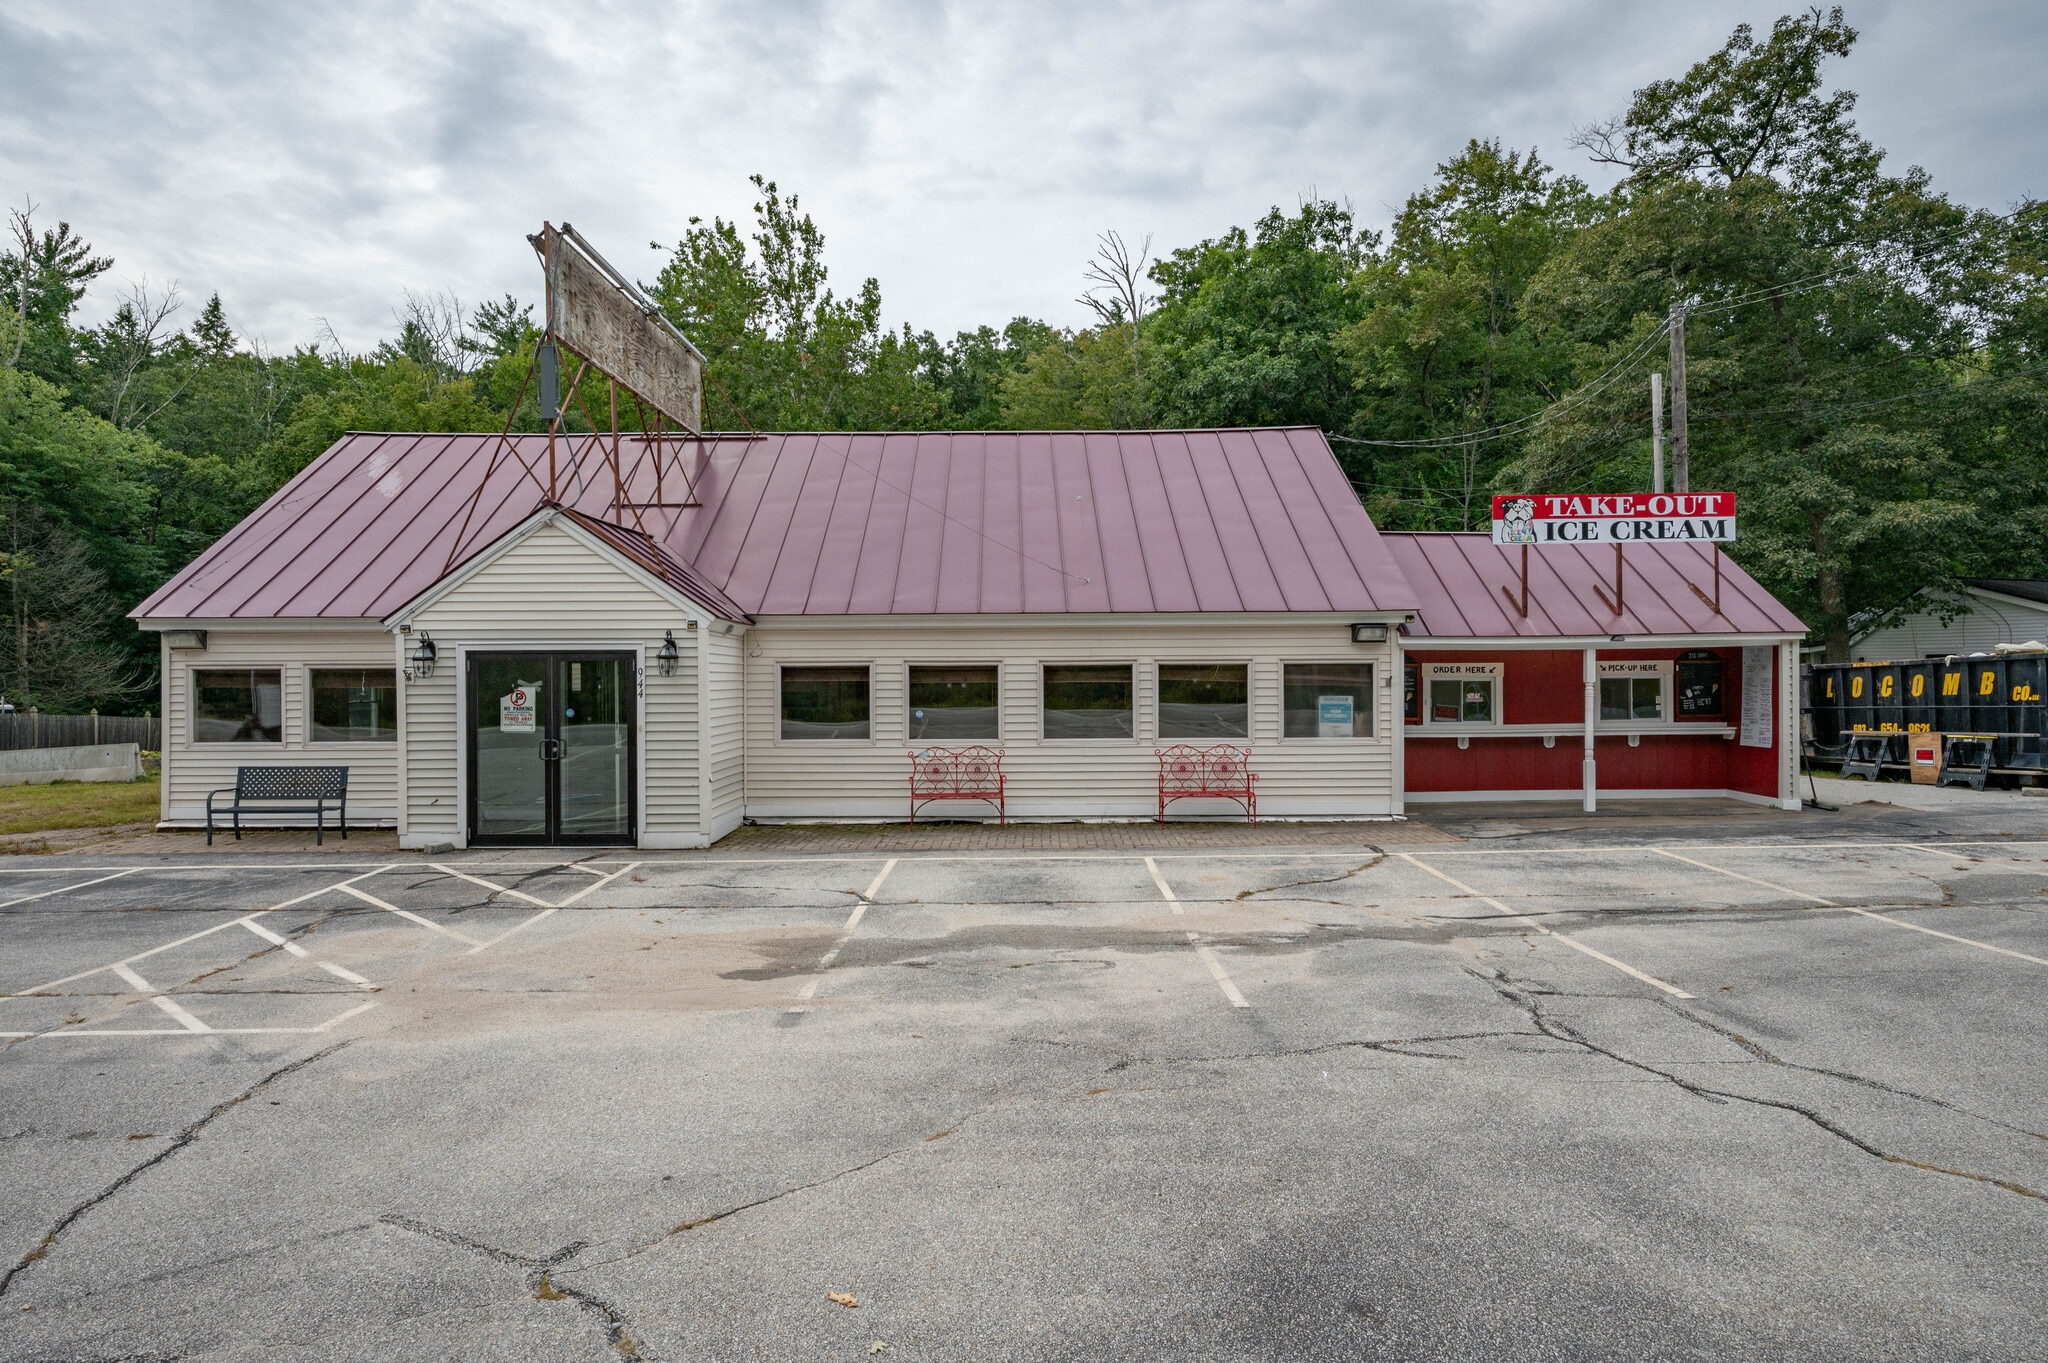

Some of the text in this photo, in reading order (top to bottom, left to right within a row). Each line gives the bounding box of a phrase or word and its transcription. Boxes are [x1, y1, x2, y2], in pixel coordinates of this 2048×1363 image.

[1545, 496, 1722, 517] TAKE-OUT
[1544, 520, 1729, 541] ICE CREAM
[1433, 666, 1487, 674] ORDER HERE
[1608, 664, 1658, 672] PICK-UP HERE
